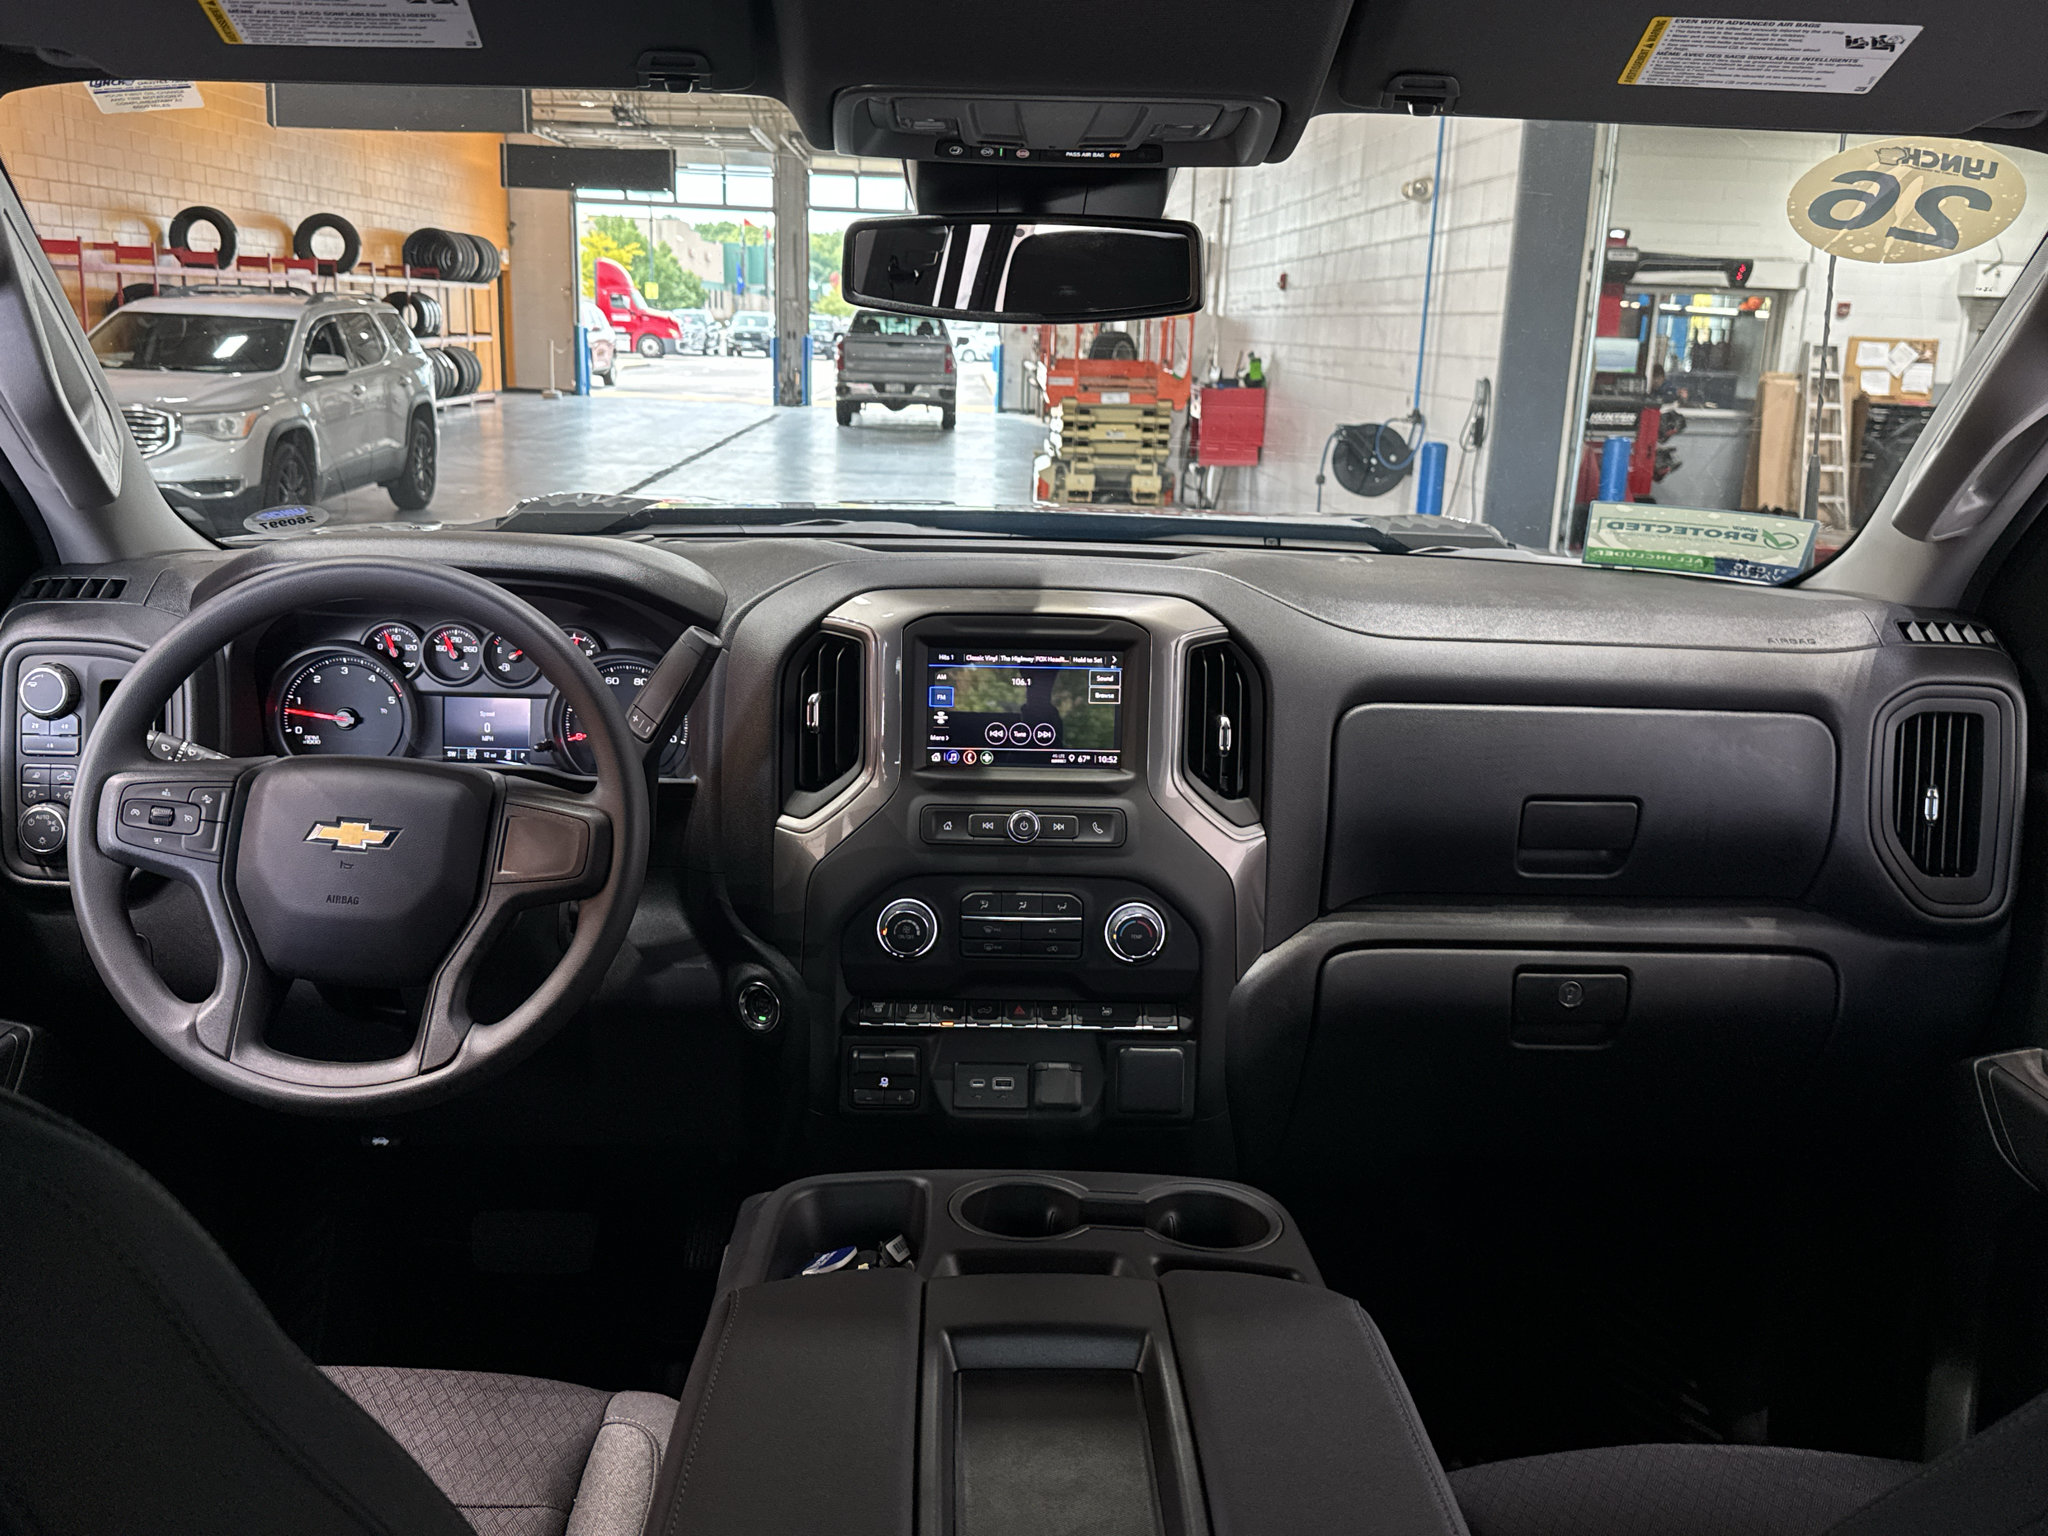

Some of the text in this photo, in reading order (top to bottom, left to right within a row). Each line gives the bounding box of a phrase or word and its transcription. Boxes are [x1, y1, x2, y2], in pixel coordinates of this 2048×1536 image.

[340, 666, 349, 675] 3
[313, 675, 322, 683] 2
[367, 675, 377, 683] 4
[605, 677, 620, 686] 60
[1012, 678, 1031, 686] 106.1
[296, 697, 302, 705] 1
[387, 696, 396, 704] 5
[480, 710, 496, 718] Speed
[294, 726, 303, 734] 0
[484, 722, 491, 733] 0
[326, 894, 360, 905] AIRBAG
